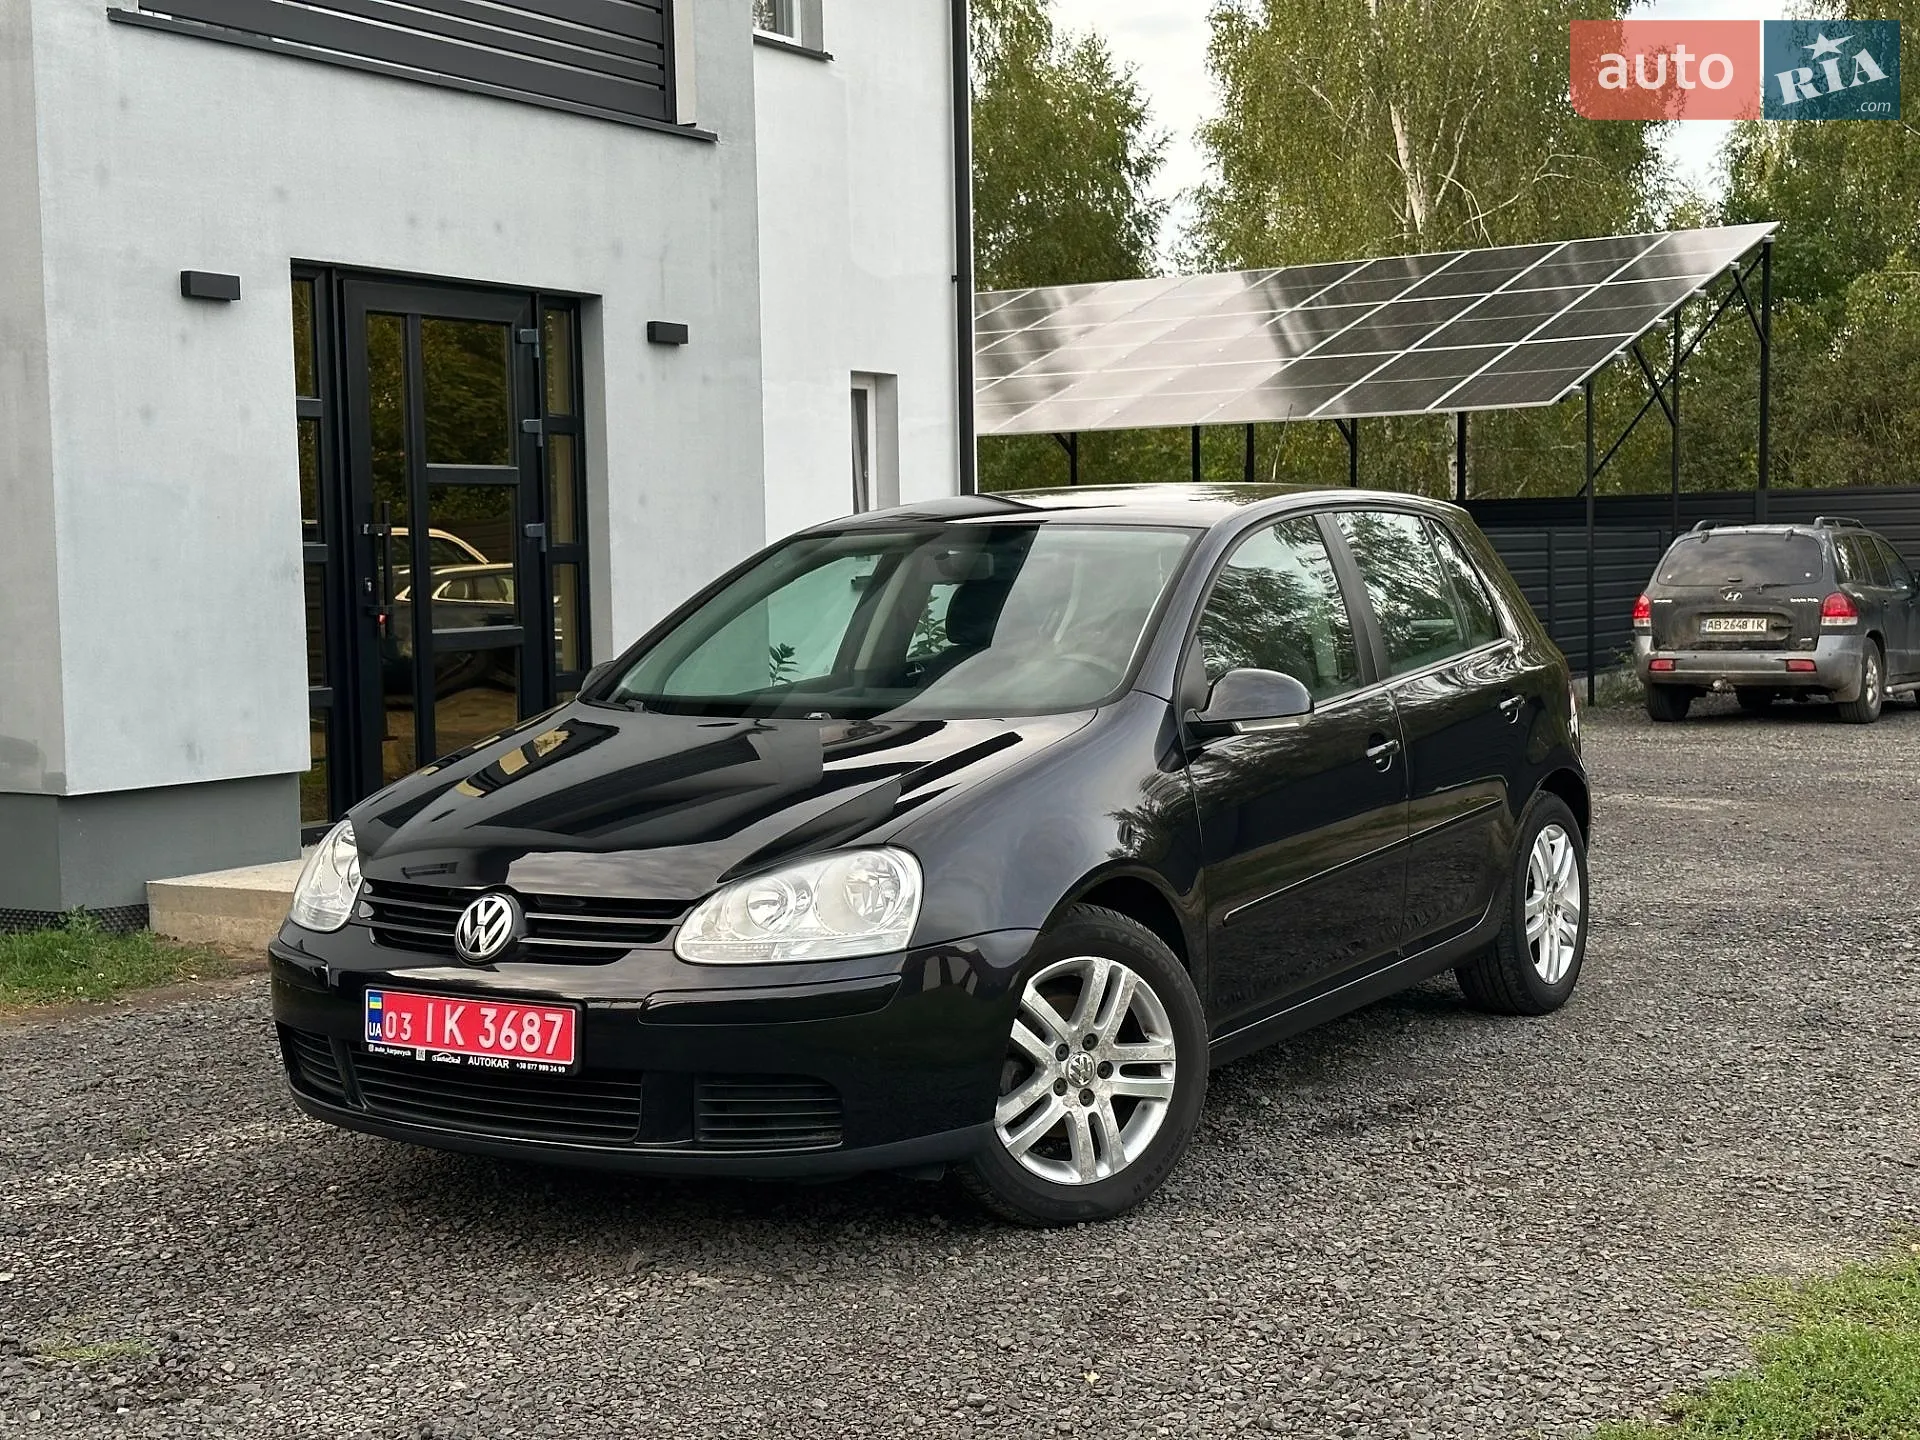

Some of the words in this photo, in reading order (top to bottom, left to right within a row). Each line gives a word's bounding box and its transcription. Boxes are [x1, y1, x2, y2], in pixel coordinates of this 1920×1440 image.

[1751, 620, 1764, 630] IK
[368, 1021, 383, 1038] UA
[385, 1011, 413, 1042] 03
[425, 1003, 465, 1047] IK
[478, 1007, 564, 1055] 3687
[467, 1055, 510, 1069] AUTOKAR
